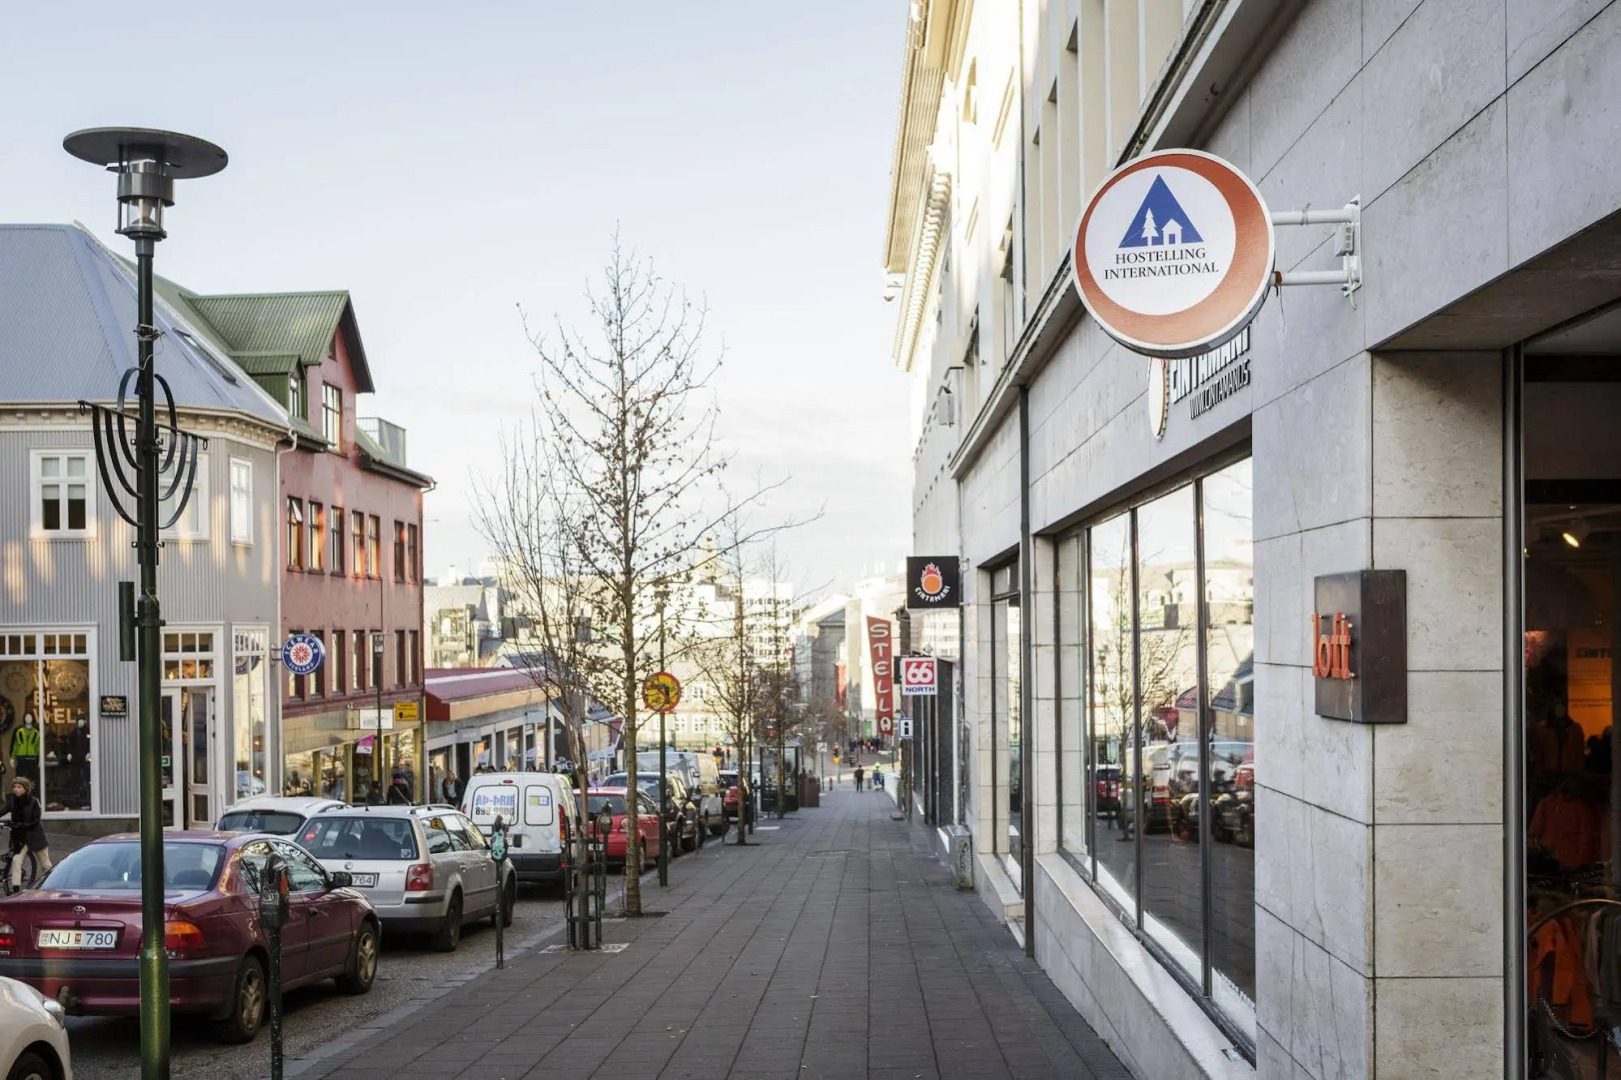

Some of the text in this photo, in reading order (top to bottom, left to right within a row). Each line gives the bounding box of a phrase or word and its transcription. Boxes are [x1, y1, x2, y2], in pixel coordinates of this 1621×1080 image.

[1115, 247, 1206, 264] HOSTELLING
[1104, 262, 1219, 280] INTERNATIONAL
[914, 585, 951, 603] CINTAMANI
[284, 636, 319, 655] ICEWEAR
[1312, 612, 1351, 680] loft
[288, 662, 315, 672] ICELAND
[870, 623, 892, 732] STELLA
[354, 875, 372, 885] 764
[50, 933, 114, 946] NJ 780
